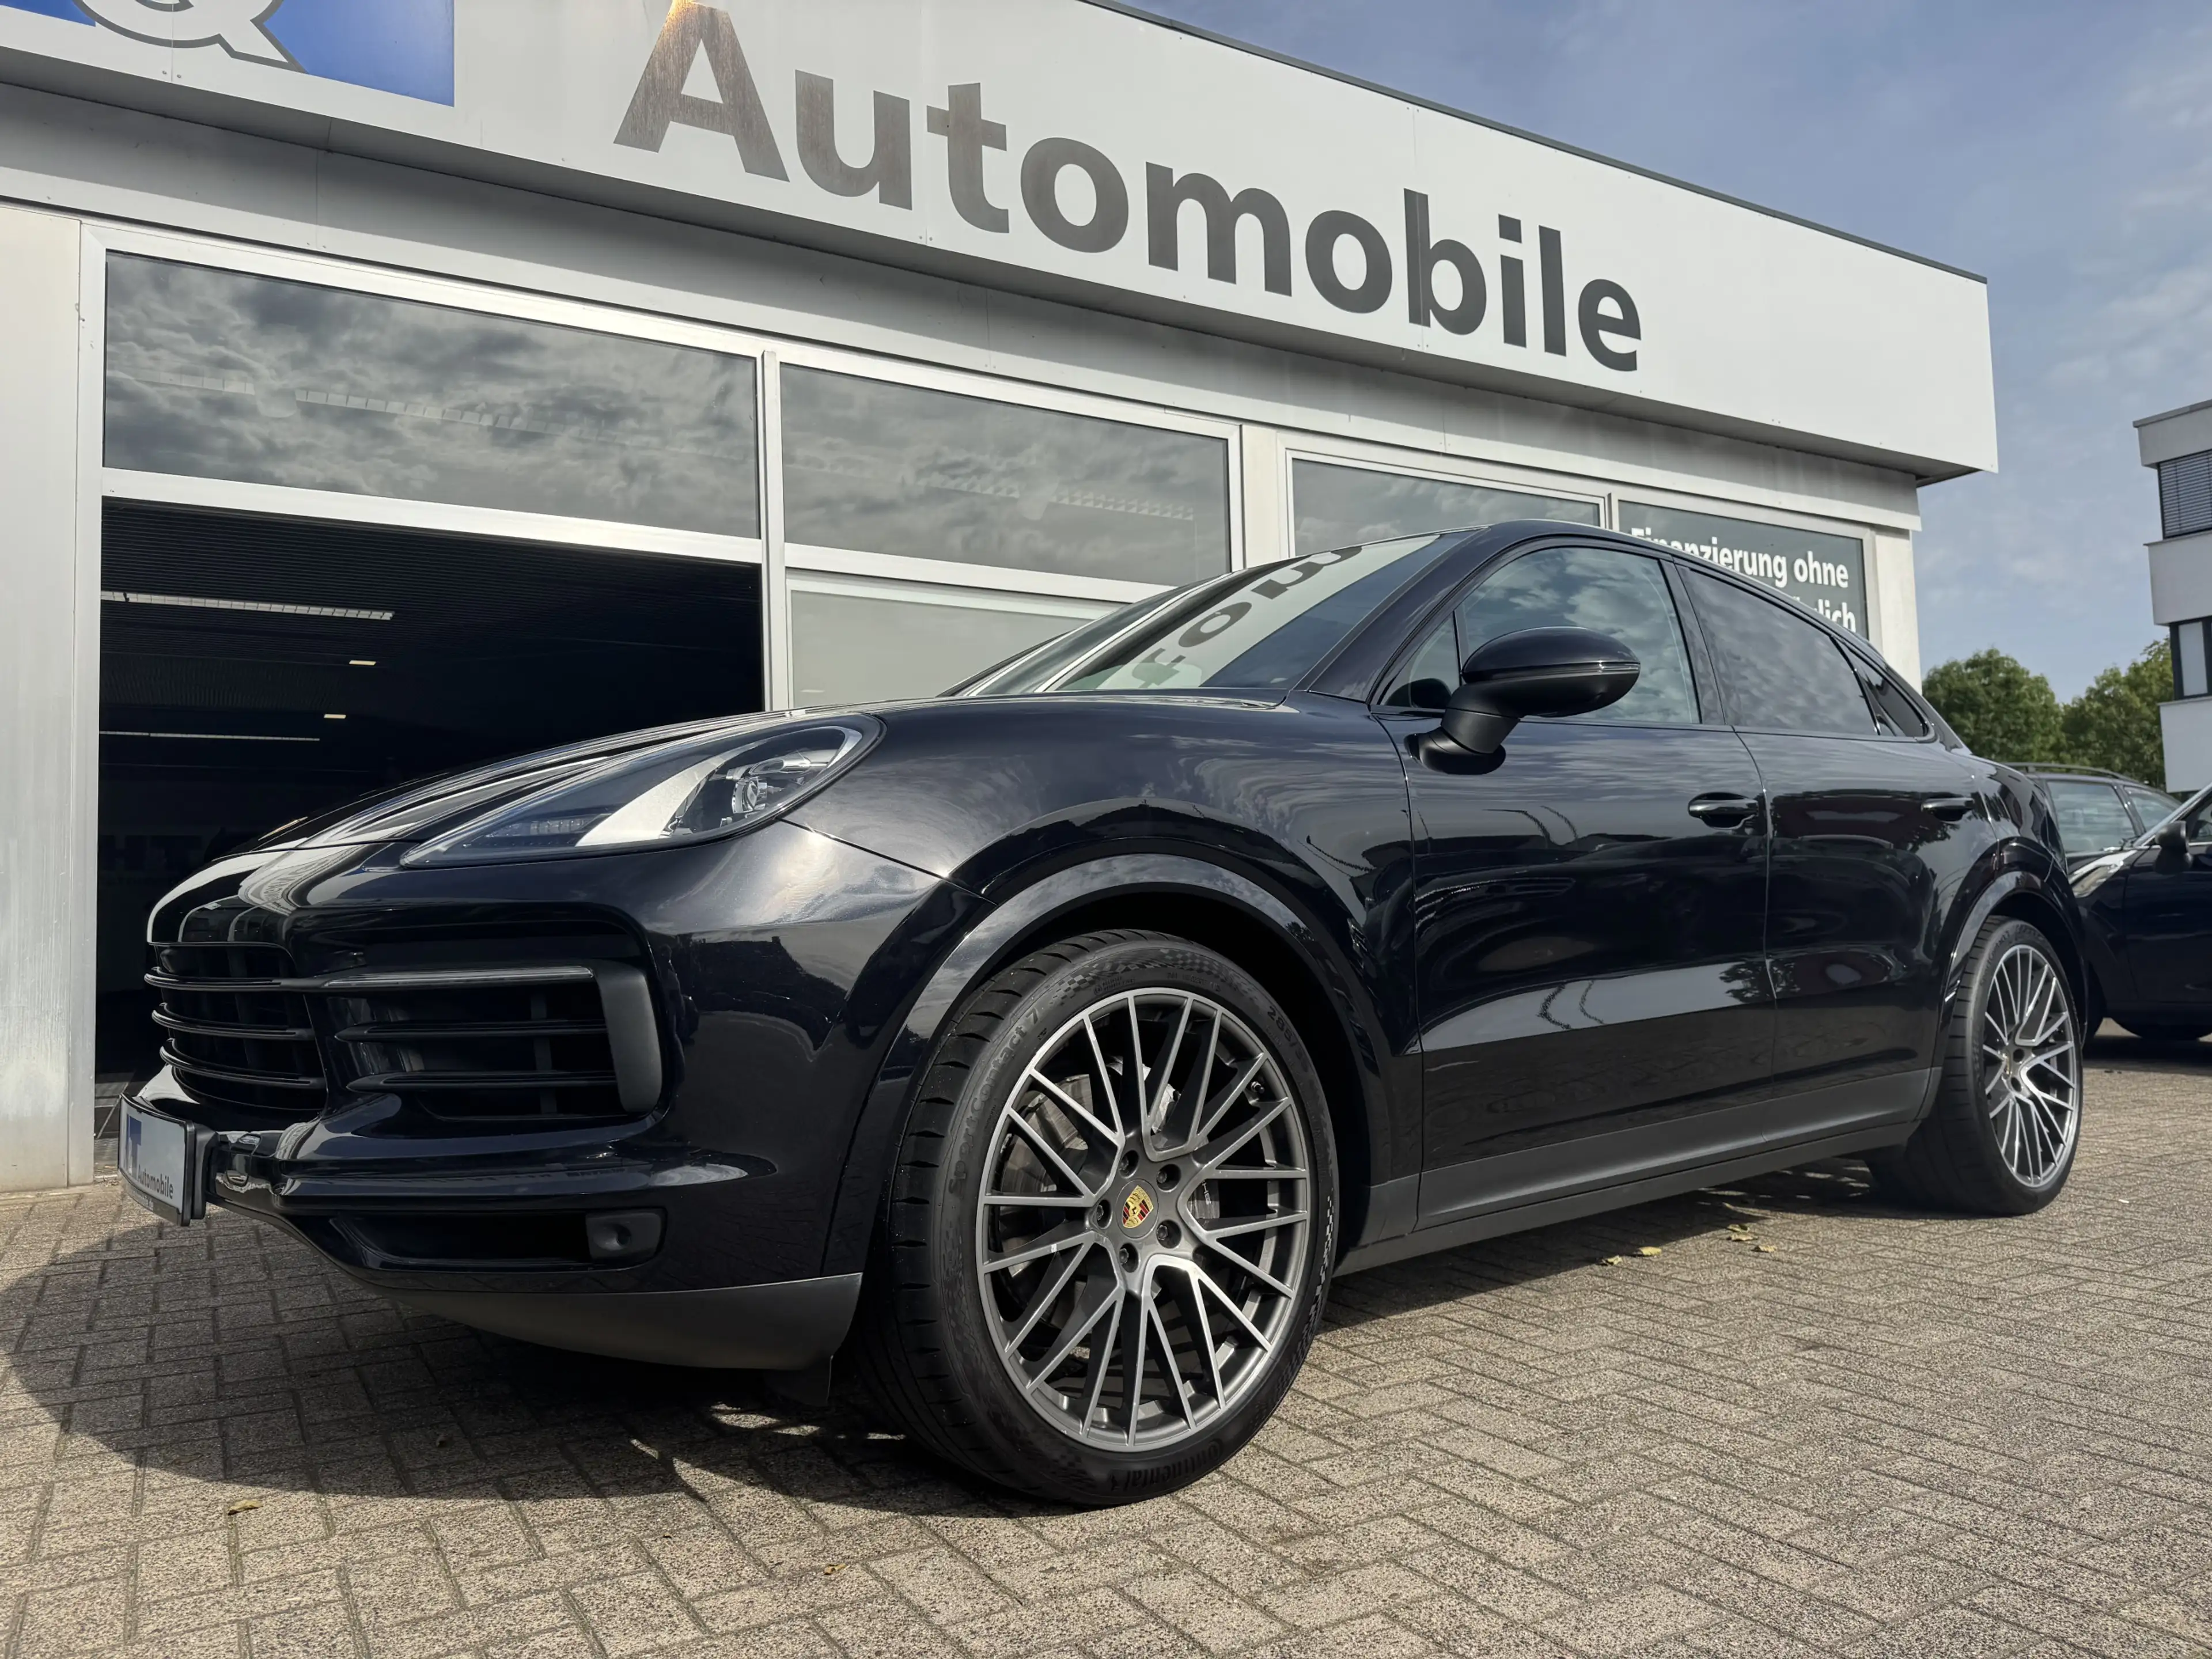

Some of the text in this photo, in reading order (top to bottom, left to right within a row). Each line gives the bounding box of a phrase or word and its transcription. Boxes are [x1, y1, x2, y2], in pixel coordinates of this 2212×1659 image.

[613, 0, 1641, 372] Automobile
[1631, 527, 1849, 588] nzierung ohne
[137, 1164, 174, 1200] Automobile
